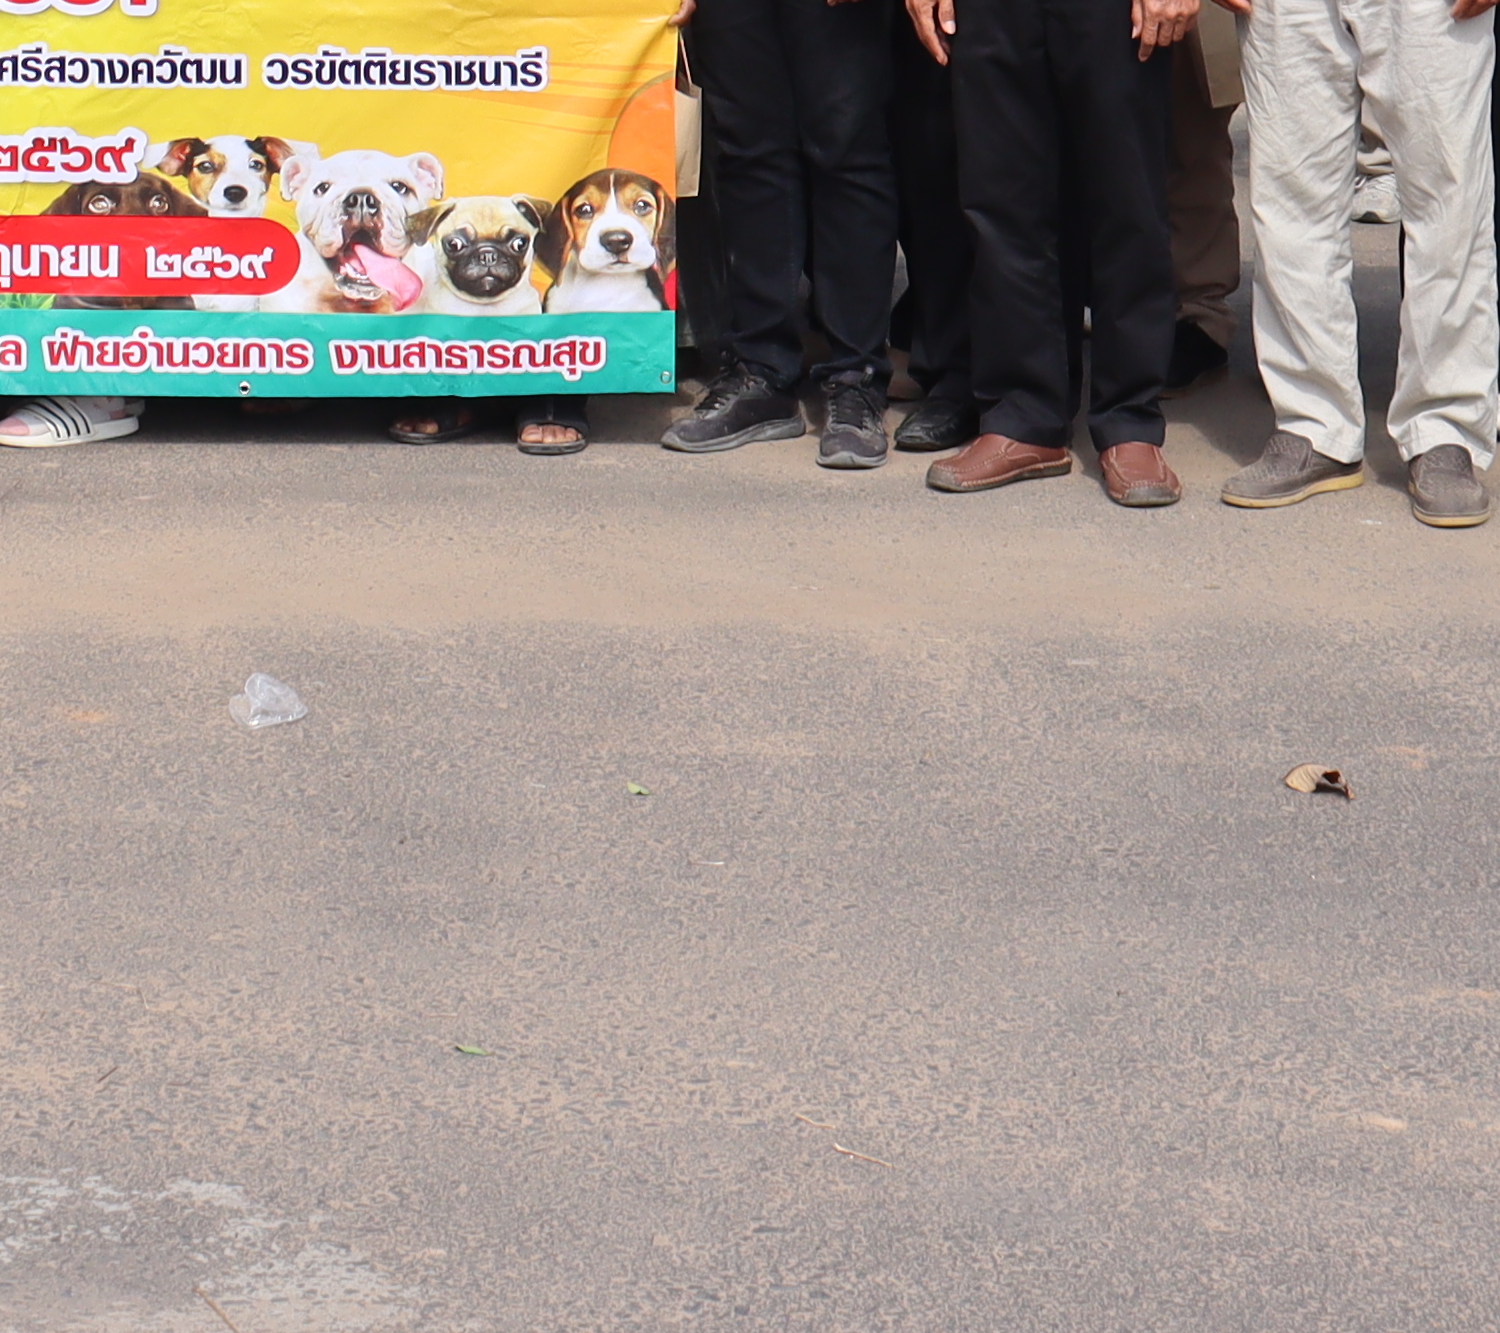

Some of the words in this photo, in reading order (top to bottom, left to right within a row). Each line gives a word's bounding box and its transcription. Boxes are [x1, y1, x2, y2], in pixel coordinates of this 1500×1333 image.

[266, 50, 542, 87] วรขัตติยราชนารี
[145, 245, 275, 279] ๒๕๖๙
[46, 331, 310, 369] ฝ่ายอำนวยการ
[334, 338, 601, 377] งานสาธารณสุข
